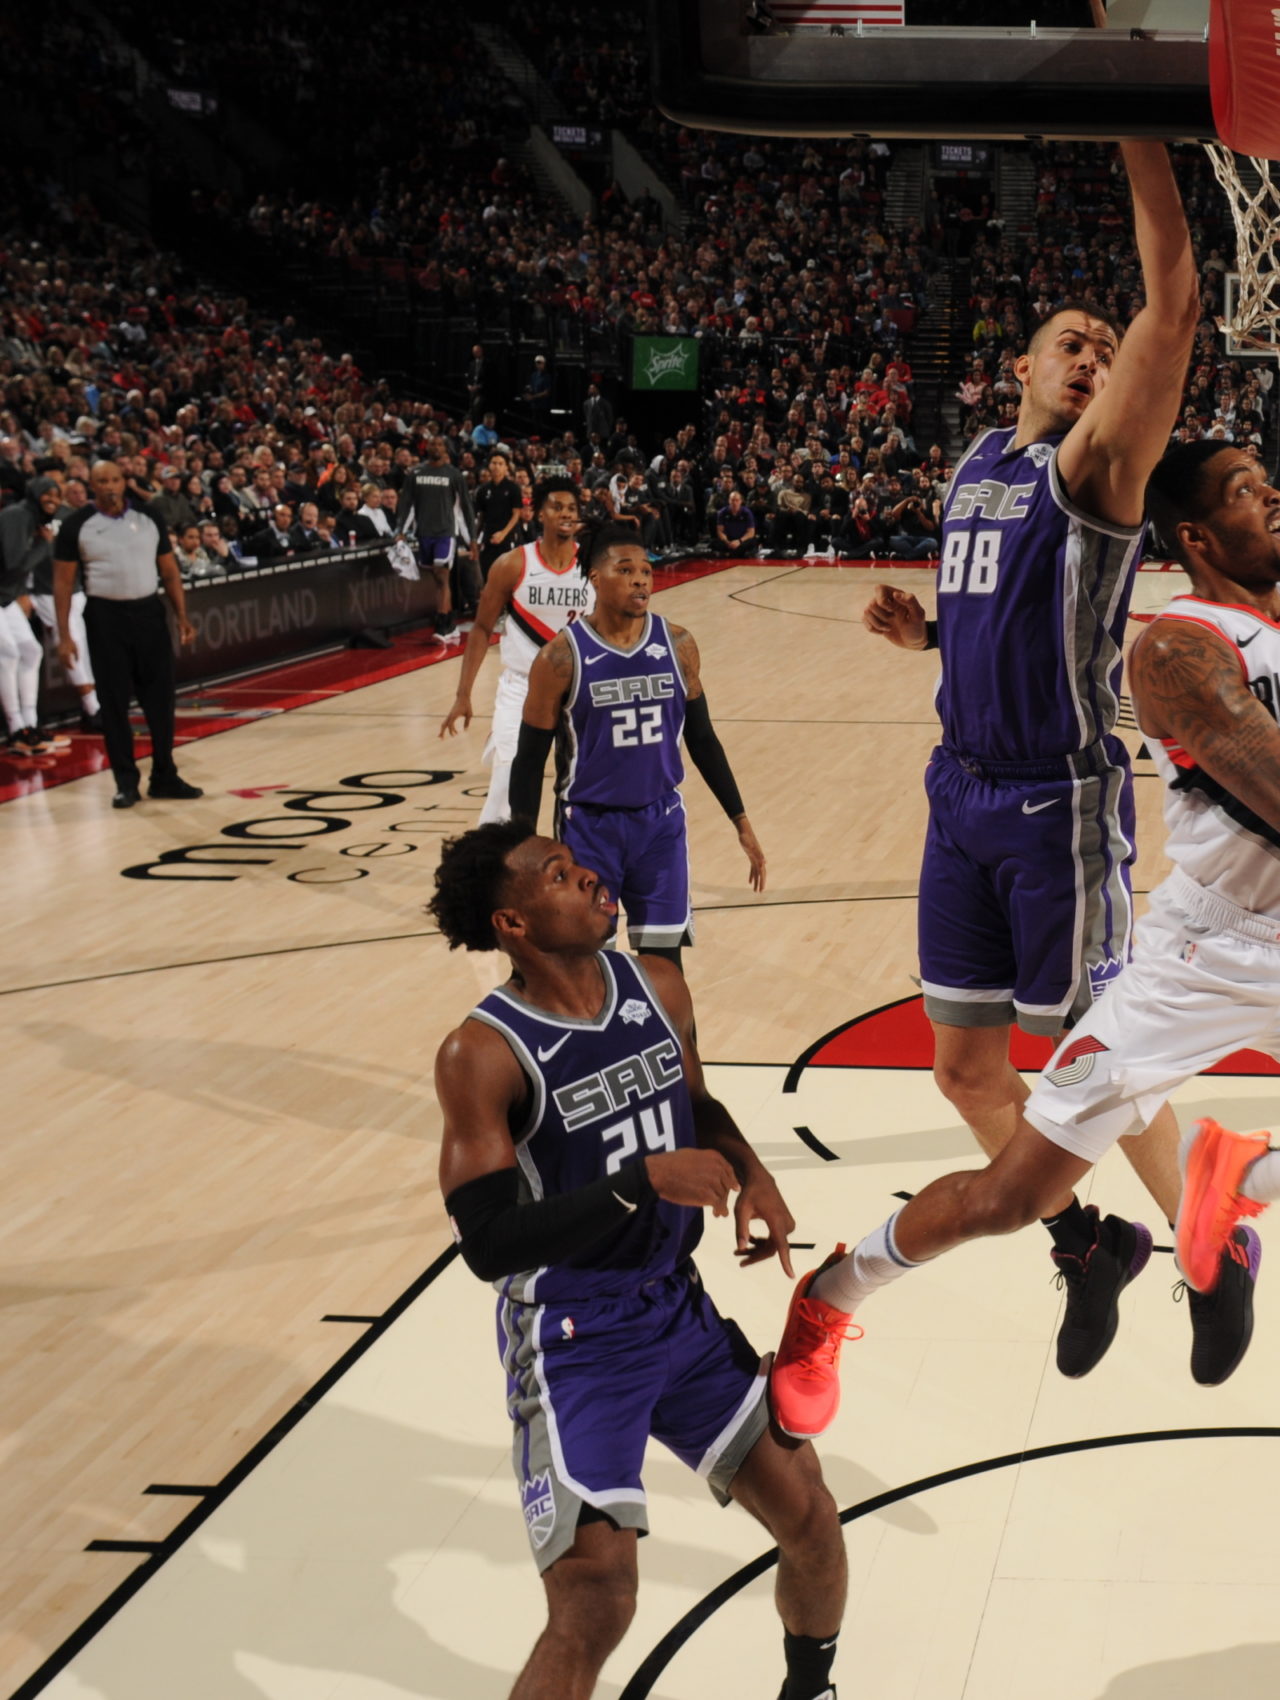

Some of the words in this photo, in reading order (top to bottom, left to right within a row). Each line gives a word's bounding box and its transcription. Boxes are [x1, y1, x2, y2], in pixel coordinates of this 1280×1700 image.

[941, 145, 973, 154] TICKETS
[650, 354, 685, 373] Sprite
[416, 475, 449, 487] KINGS
[945, 478, 1037, 523] SAC
[938, 530, 1002, 594] 88
[529, 586, 588, 608] BLAZERS
[188, 586, 318, 655] PORTLAND
[589, 672, 675, 708] SAC
[611, 704, 664, 748] 22
[120, 770, 467, 881] moda
[552, 1038, 683, 1133] SAC
[601, 1099, 676, 1176] 24
